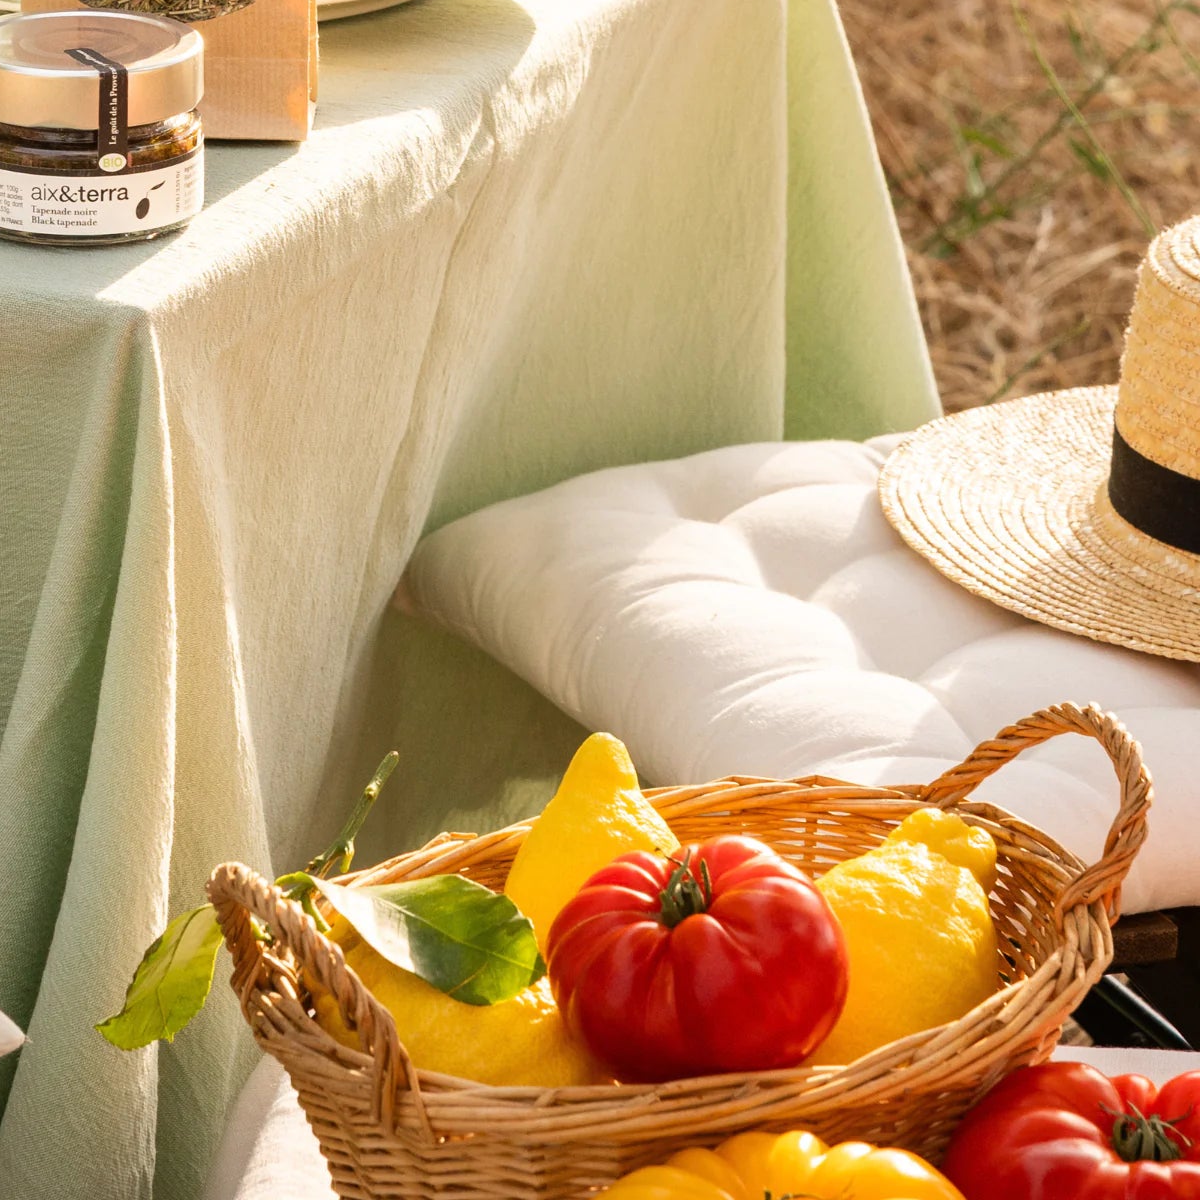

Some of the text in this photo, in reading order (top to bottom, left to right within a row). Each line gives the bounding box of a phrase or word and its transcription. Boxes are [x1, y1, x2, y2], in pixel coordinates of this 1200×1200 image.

[109, 105, 118, 116] de
[108, 134, 117, 145] Le
[102, 157, 123, 168] BIO
[31, 183, 129, 202] aix&terra
[31, 205, 98, 216] Tapenade noire
[31, 215, 98, 228] Black tapenade
